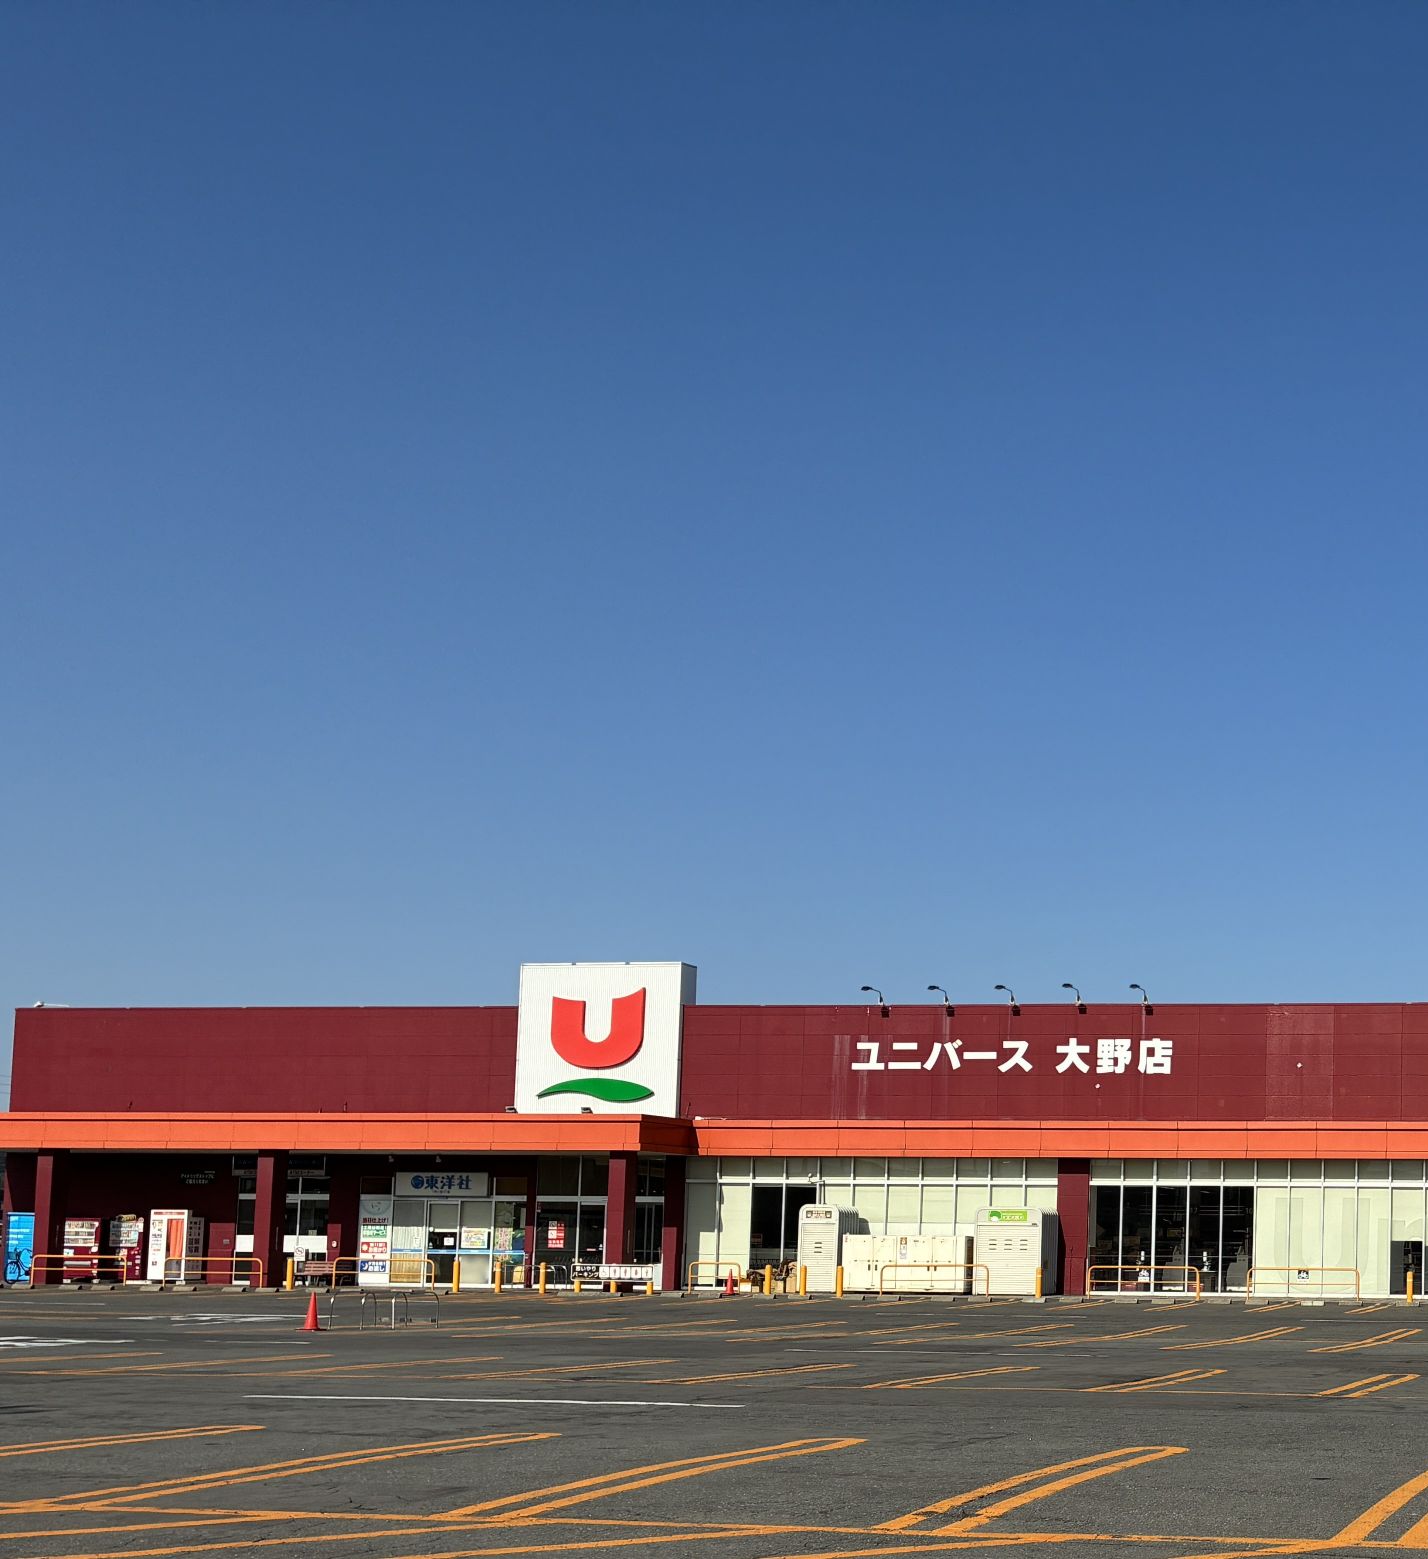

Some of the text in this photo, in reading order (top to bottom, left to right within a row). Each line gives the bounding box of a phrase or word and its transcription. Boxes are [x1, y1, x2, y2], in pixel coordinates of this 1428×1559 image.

[851, 1038, 1173, 1074] ユニバース 大野店
[425, 1174, 472, 1190] 東洋社
